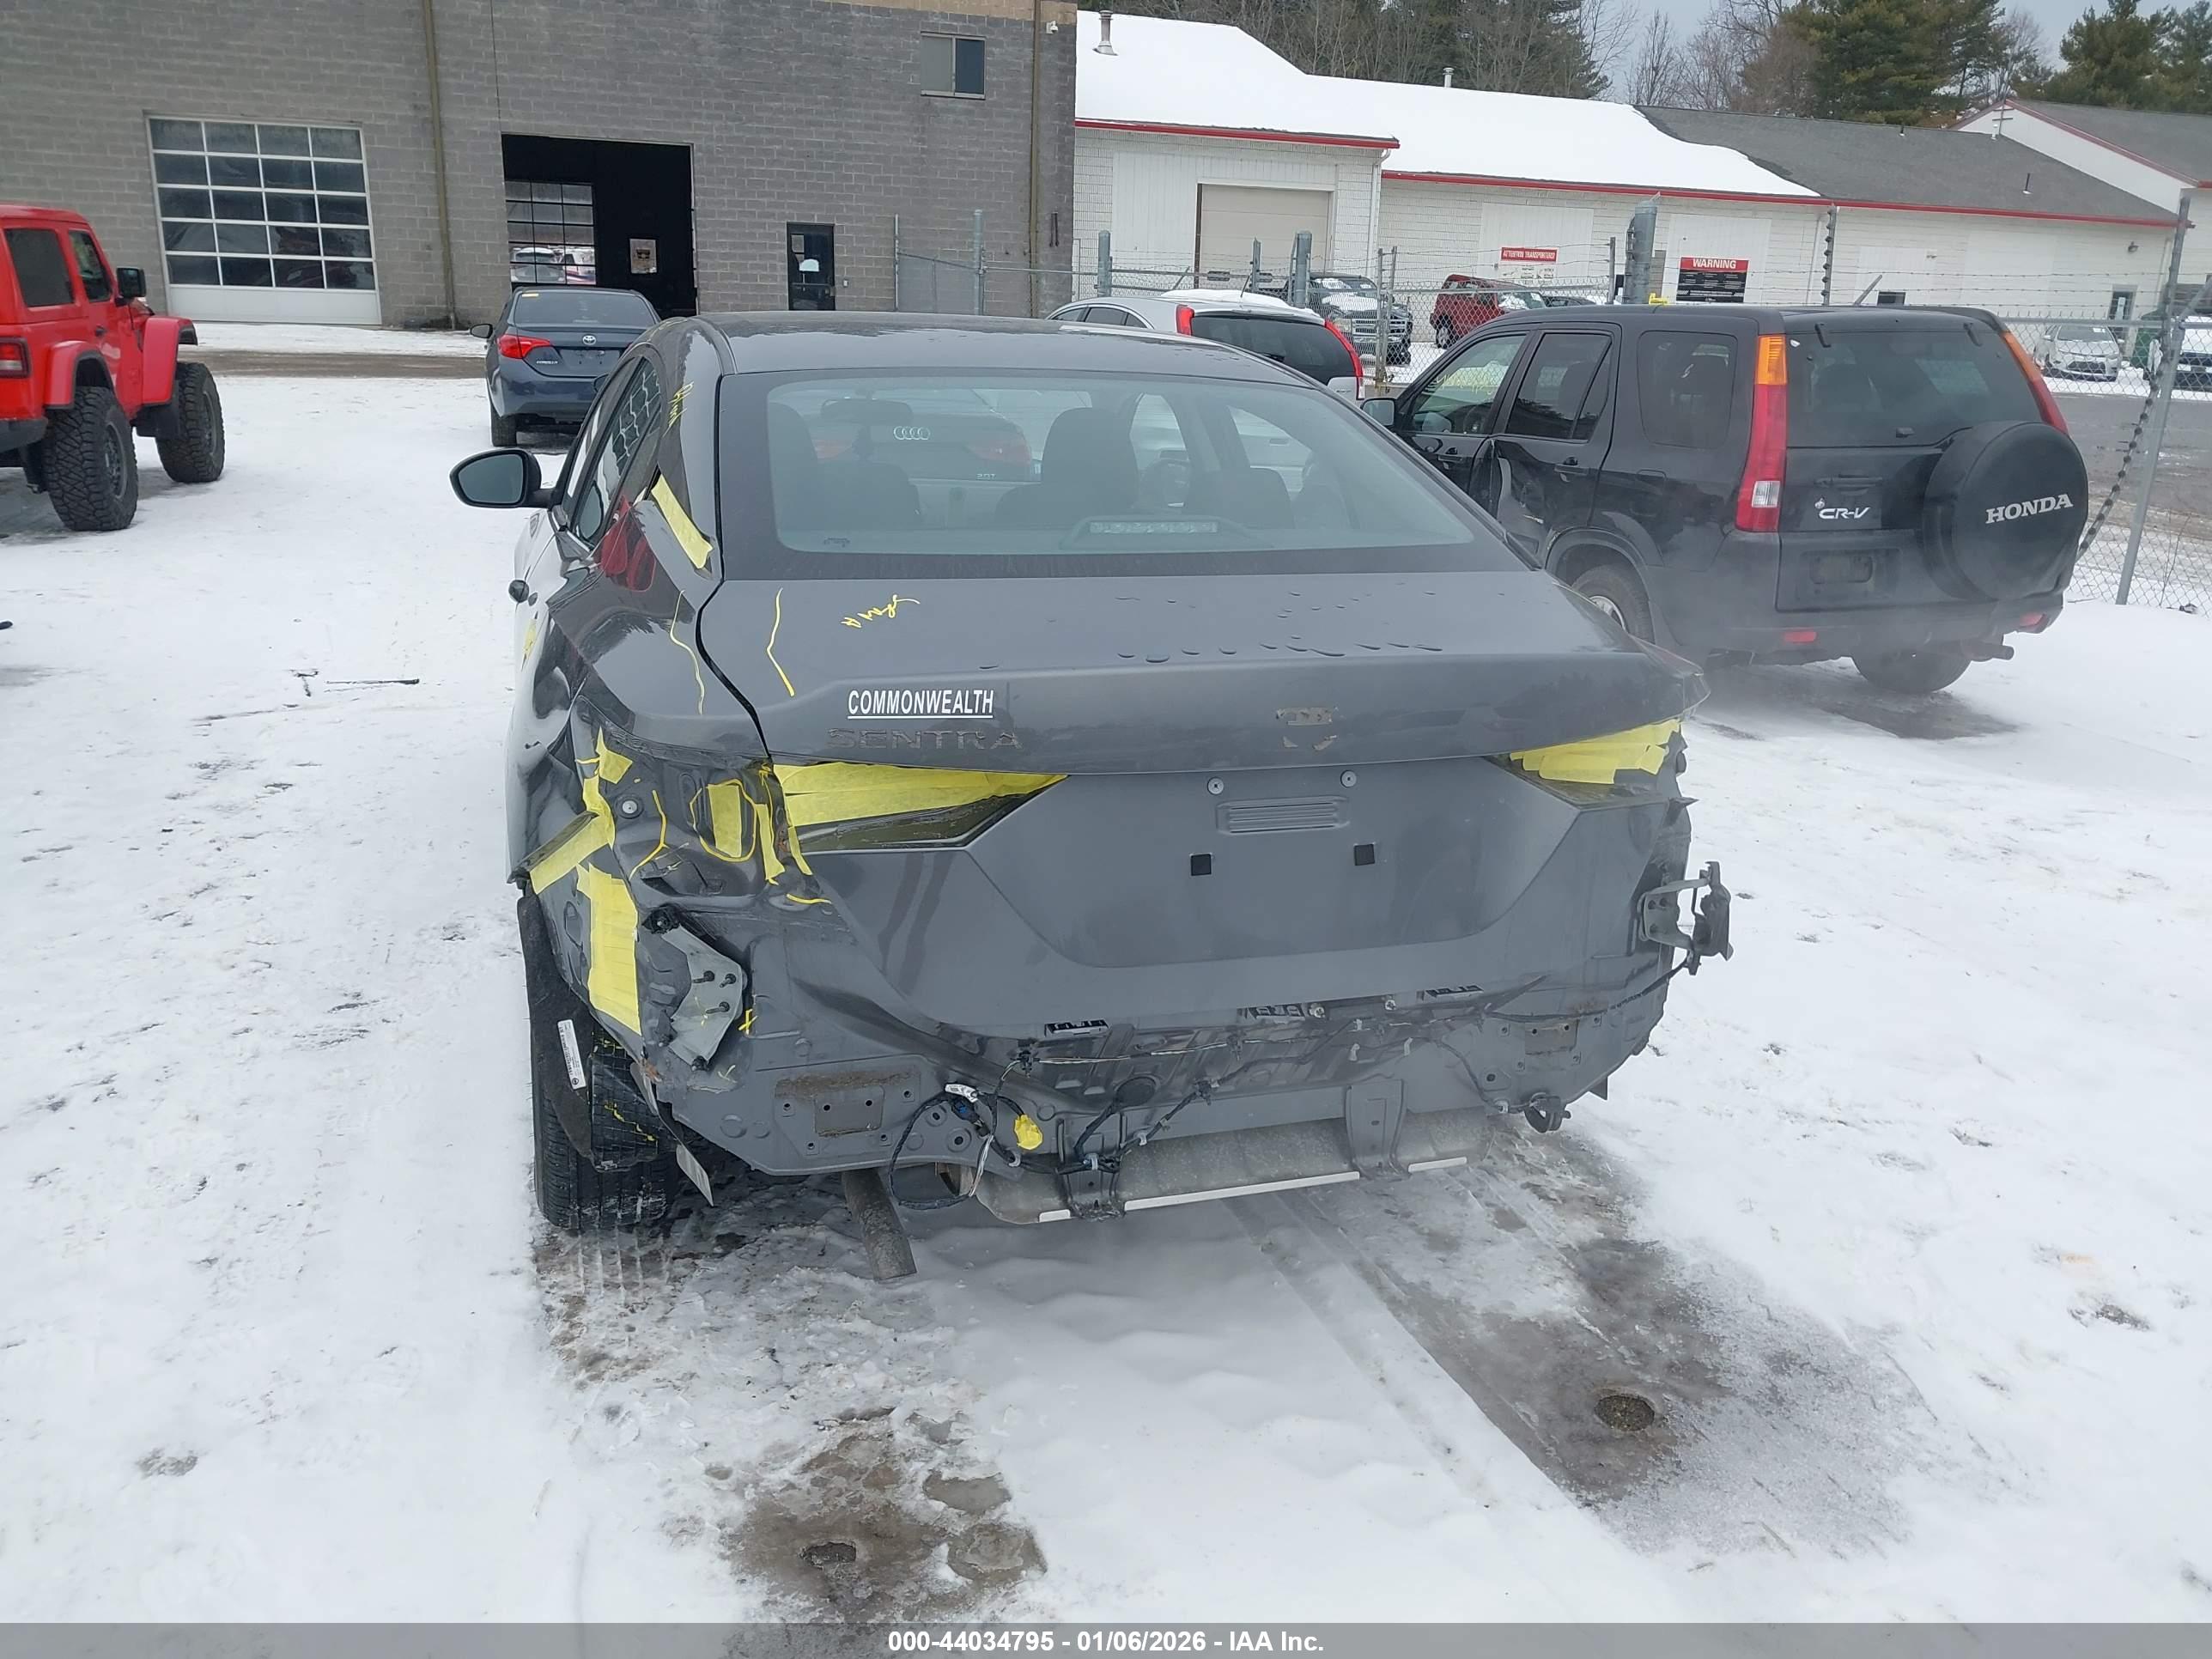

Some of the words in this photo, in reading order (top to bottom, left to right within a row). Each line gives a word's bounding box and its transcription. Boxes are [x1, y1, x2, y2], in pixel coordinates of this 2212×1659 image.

[1692, 258, 1736, 269] WARNING
[1818, 507, 1870, 520] CR-V
[1985, 494, 2074, 524] HONDA
[848, 690, 994, 715] COMMONWEALTH
[826, 729, 1024, 750] SENTRA
